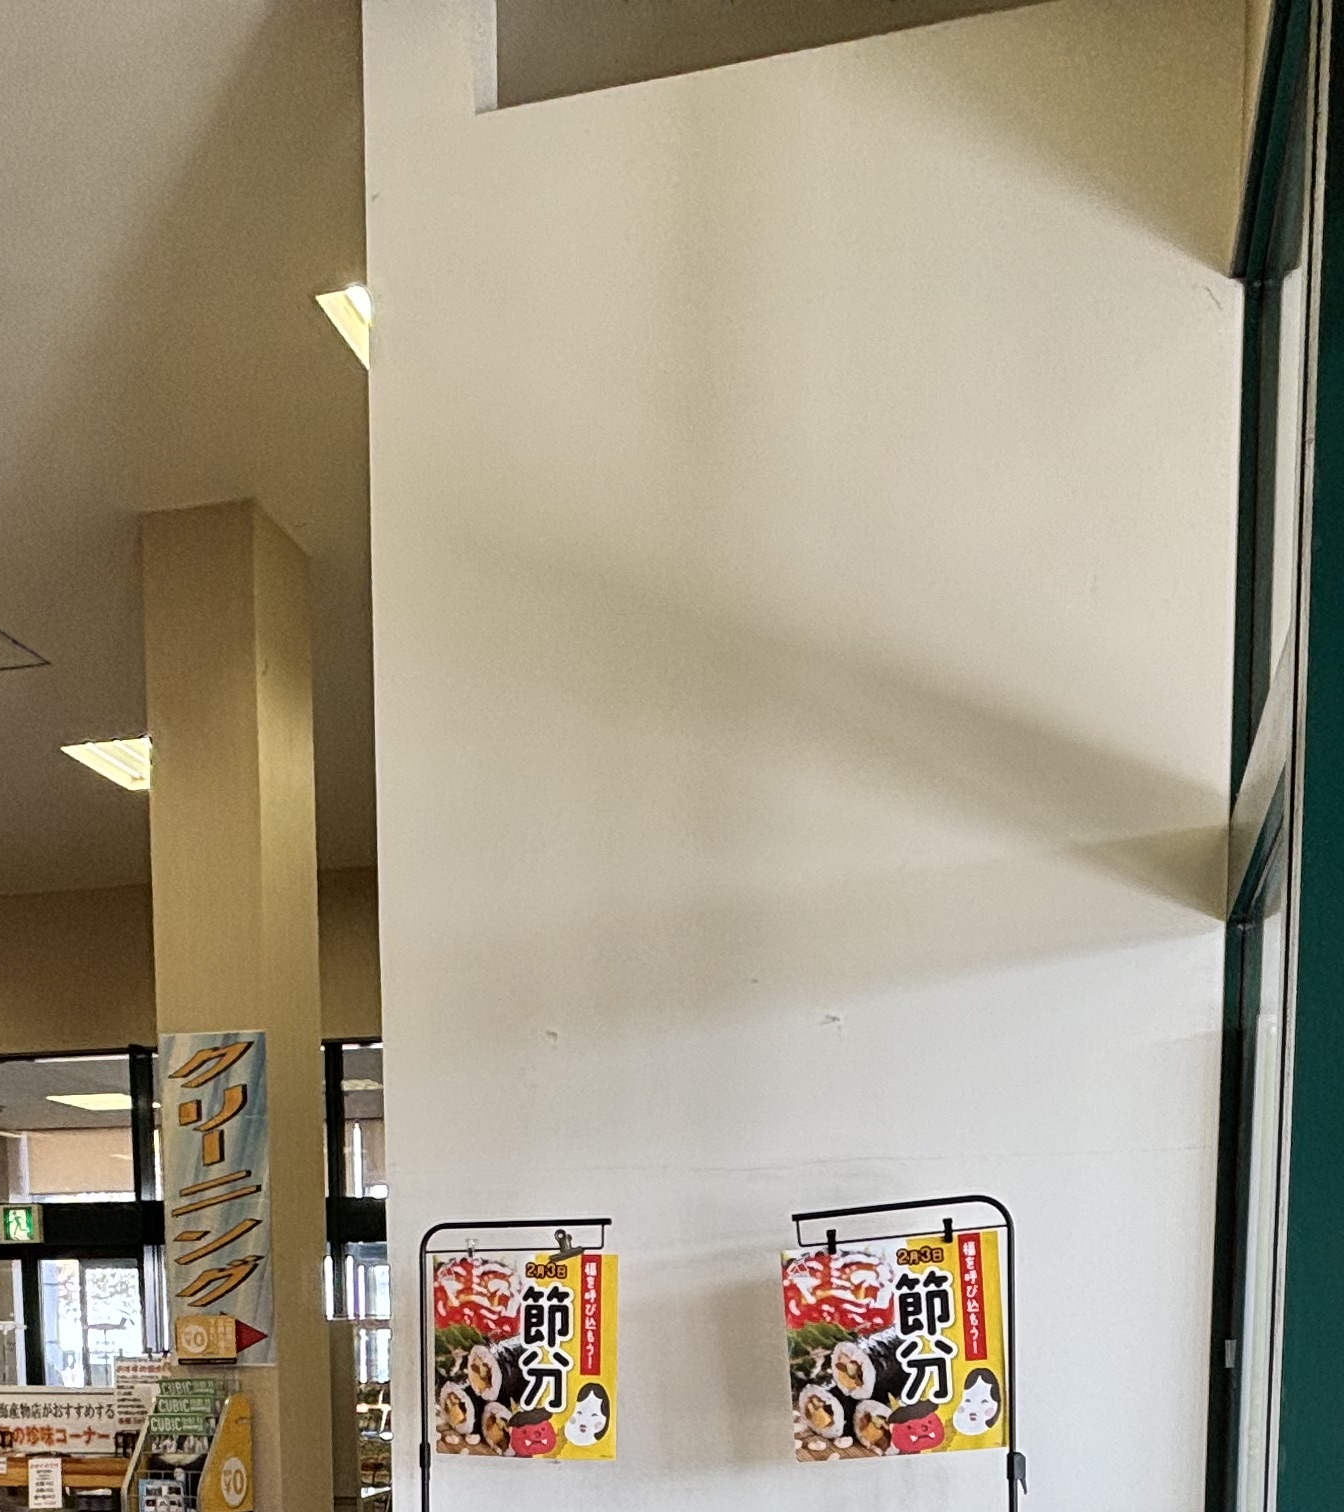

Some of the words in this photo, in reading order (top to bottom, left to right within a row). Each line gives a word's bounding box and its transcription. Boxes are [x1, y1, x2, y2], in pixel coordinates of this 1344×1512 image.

[896, 1245, 944, 1265] 2月3日
[525, 1261, 568, 1279] 2月3日
[895, 1270, 954, 1400] 節分
[522, 1285, 570, 1409] 節分
[158, 1398, 190, 1413] CUBIC
[150, 1417, 182, 1432] CUBIC
